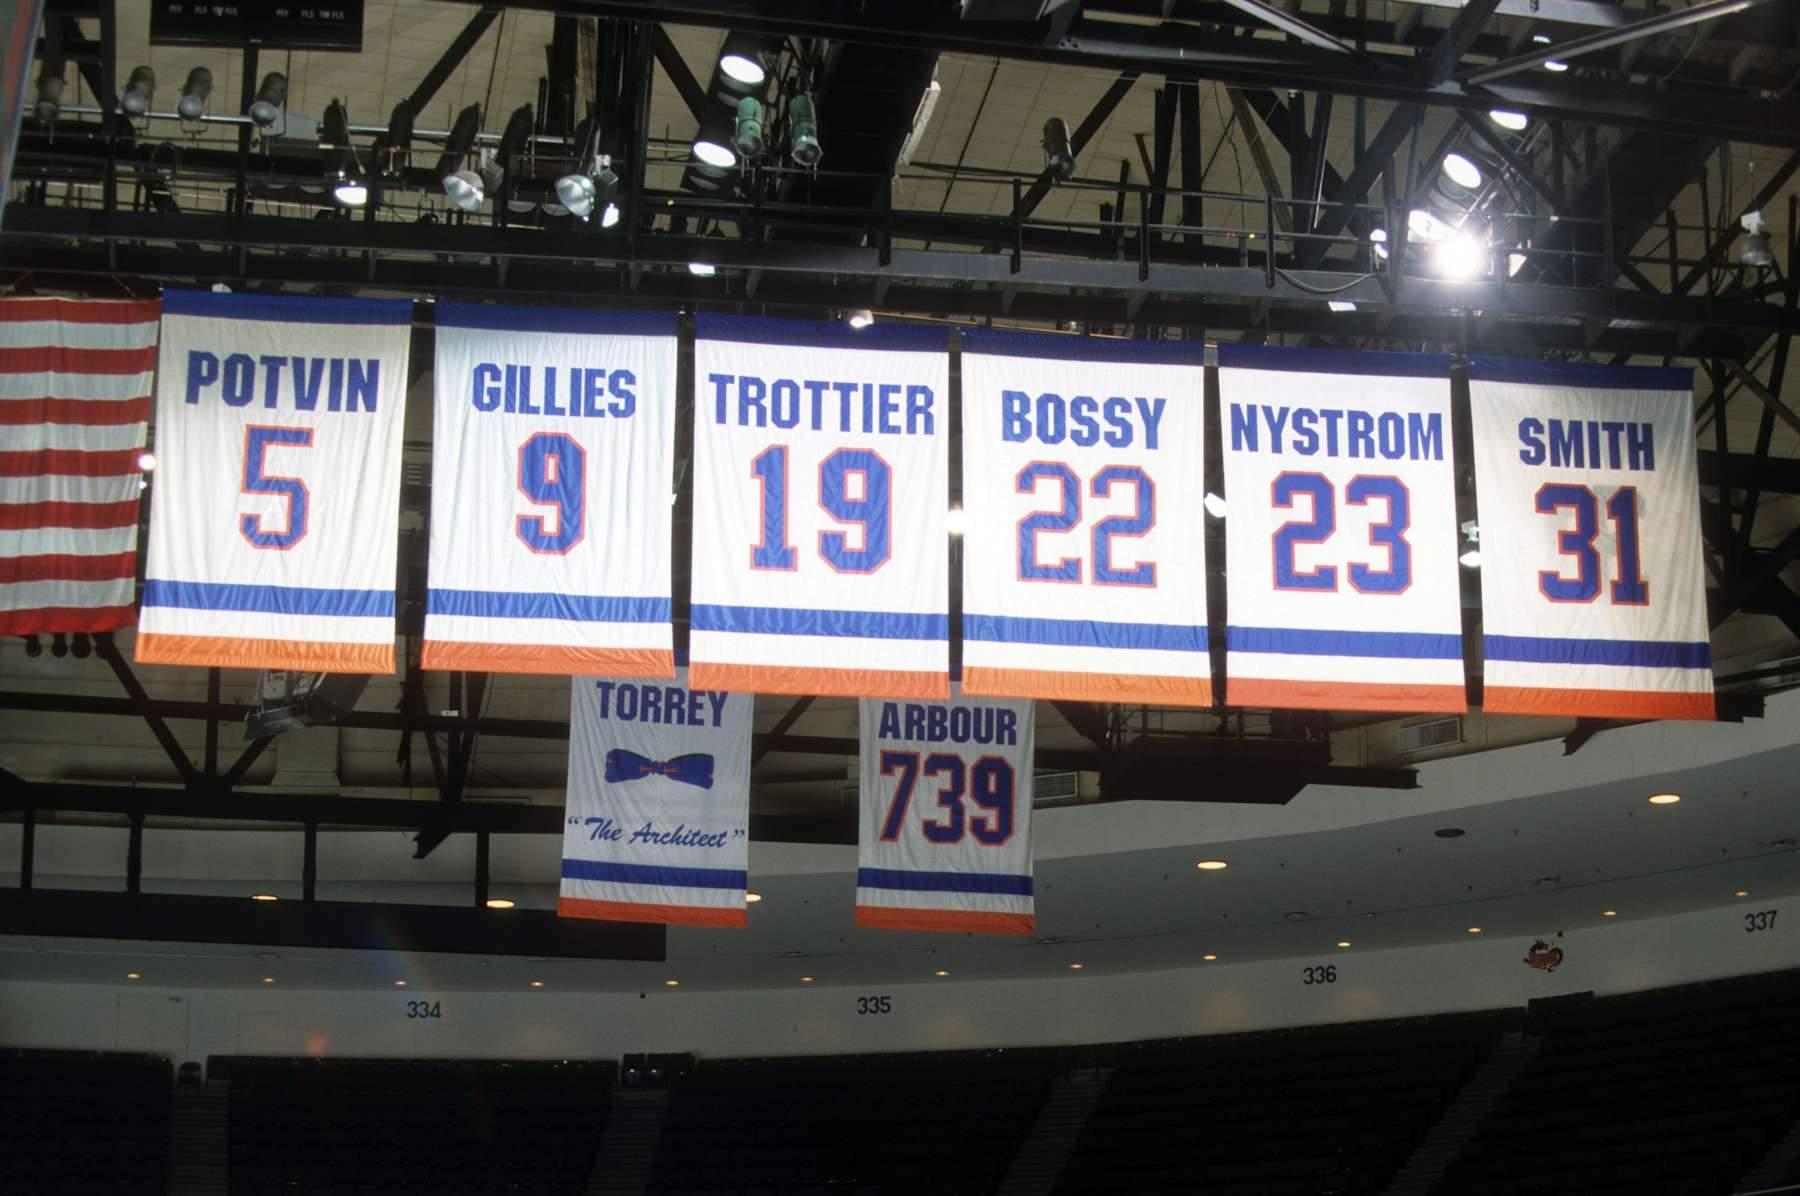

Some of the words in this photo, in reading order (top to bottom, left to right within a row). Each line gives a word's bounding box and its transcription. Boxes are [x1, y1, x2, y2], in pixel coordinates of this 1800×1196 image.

[186, 350, 380, 413] POTVIN
[472, 363, 637, 418] GILLIES
[708, 373, 935, 435] TROTTIER
[1001, 389, 1166, 450] BOSSY
[1230, 402, 1444, 461] NYSTROM
[1518, 416, 1655, 471] SMITH
[239, 424, 314, 551] 5
[515, 431, 587, 556] 9
[749, 444, 893, 575] 19
[1014, 460, 1158, 588] 22
[1270, 470, 1413, 596] 23
[1534, 482, 1650, 607] 31
[596, 681, 729, 727] TORREY
[878, 702, 1017, 746] ARBOUR
[879, 749, 1016, 847] 739
[1744, 909, 1778, 933] 337
[857, 995, 892, 1016] 335
[1302, 964, 1337, 986] 336
[407, 1000, 442, 1020] 334
